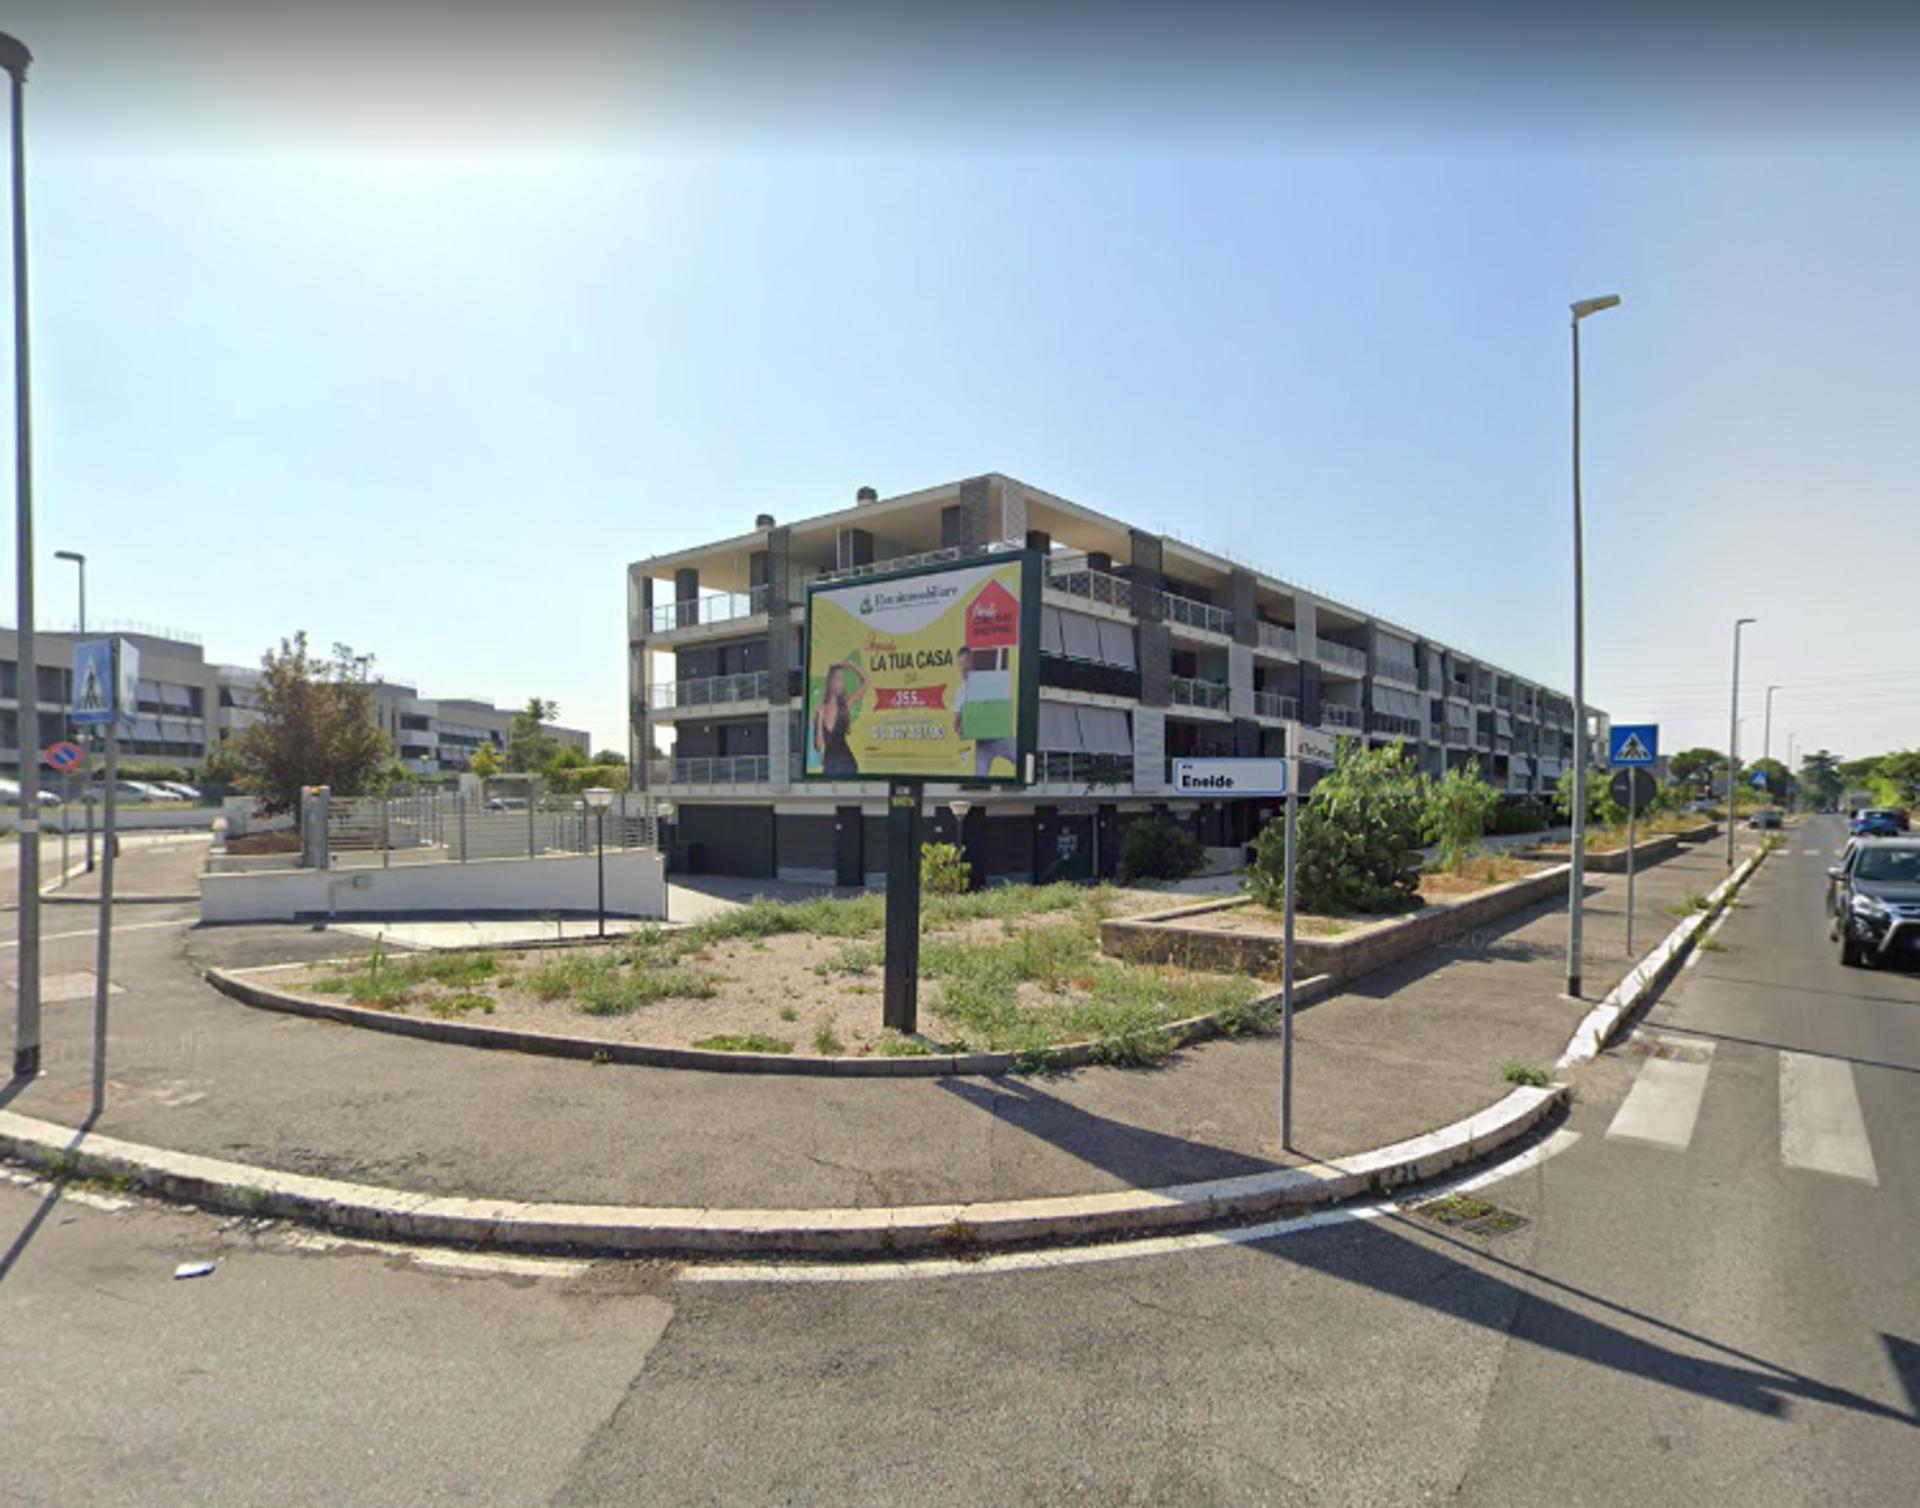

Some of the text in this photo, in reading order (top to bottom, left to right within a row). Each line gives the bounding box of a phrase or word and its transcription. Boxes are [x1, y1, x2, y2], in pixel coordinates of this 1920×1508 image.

[870, 648, 953, 672] LA TUA CASA
[1182, 774, 1235, 789] Eneide
